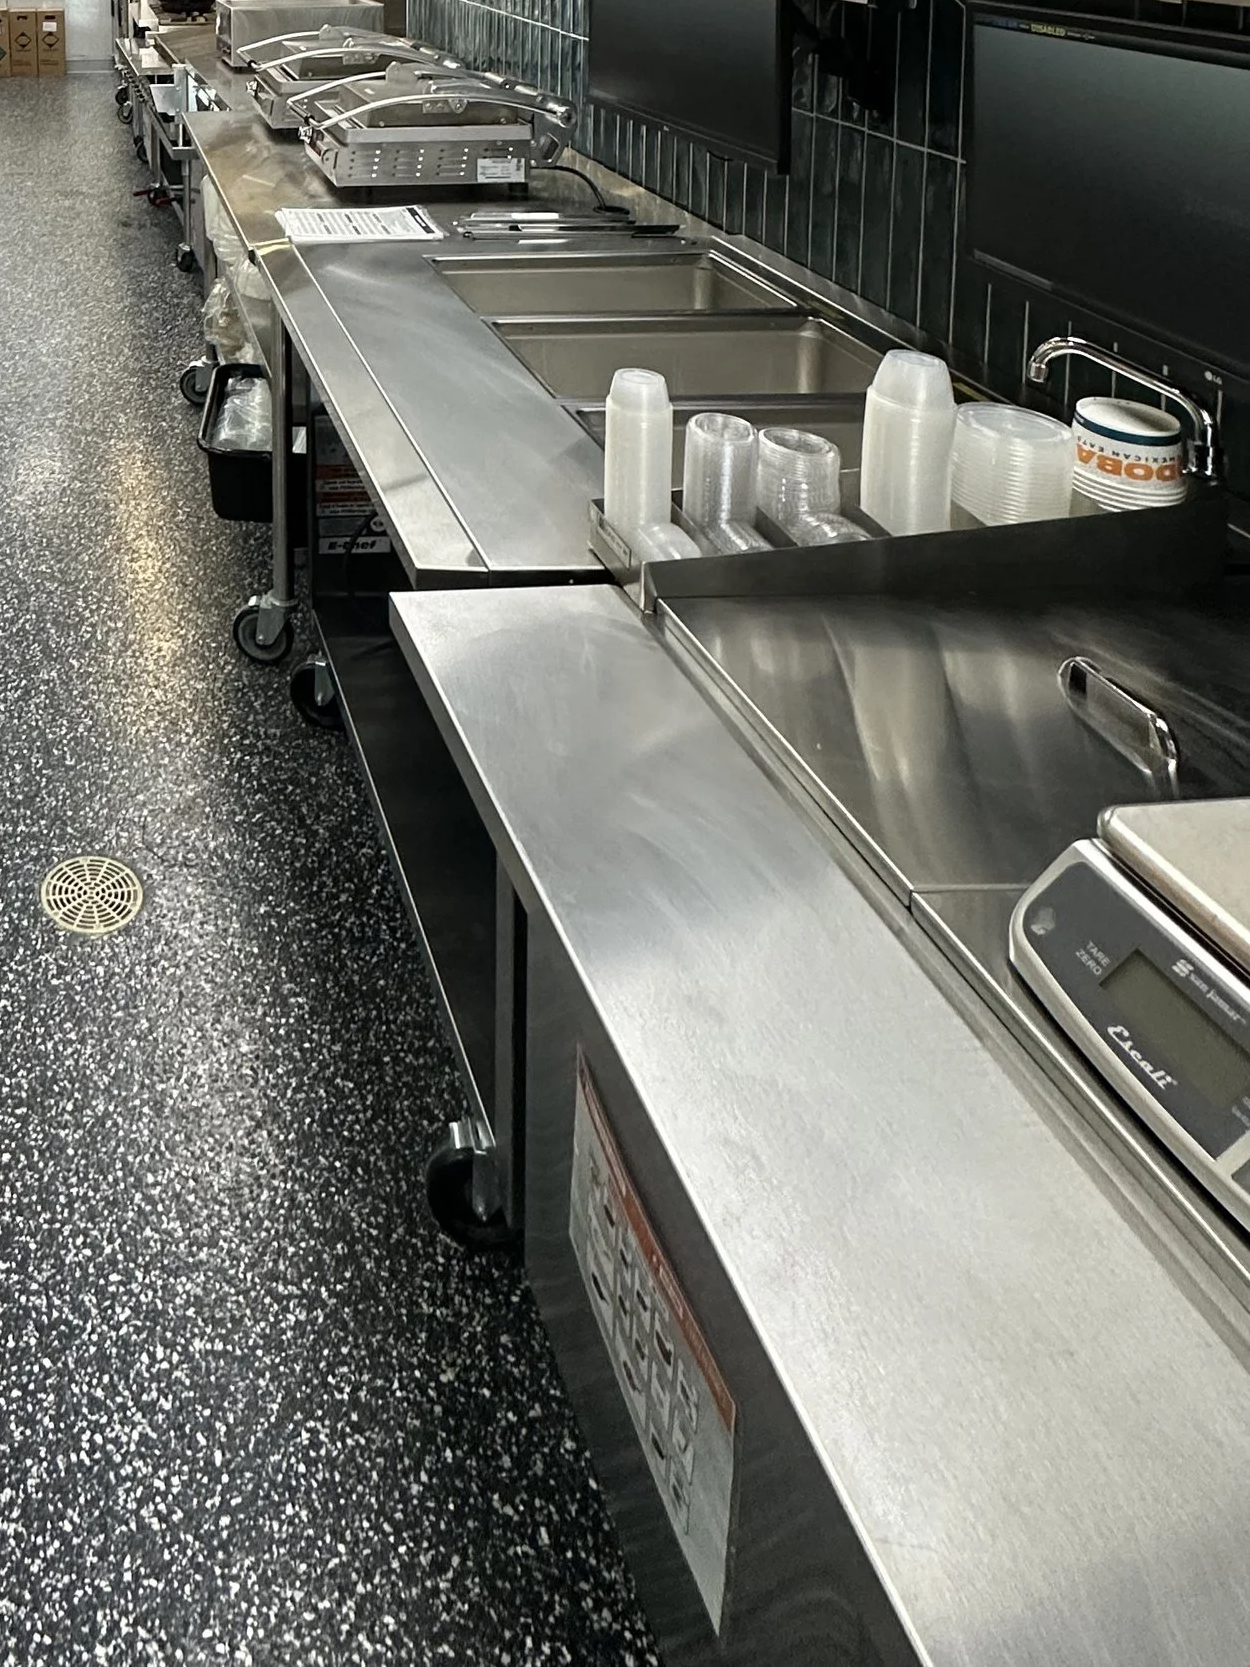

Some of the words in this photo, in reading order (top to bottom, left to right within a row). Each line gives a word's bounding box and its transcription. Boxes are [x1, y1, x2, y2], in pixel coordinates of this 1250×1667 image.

[1077, 435, 1105, 453] EATS
[1111, 450, 1176, 464] MEXICAN
[1076, 443, 1183, 482] DOBA
[1075, 948, 1102, 975] ZERO
[1087, 940, 1110, 967] TARE
[1107, 1025, 1173, 1090] Escali
